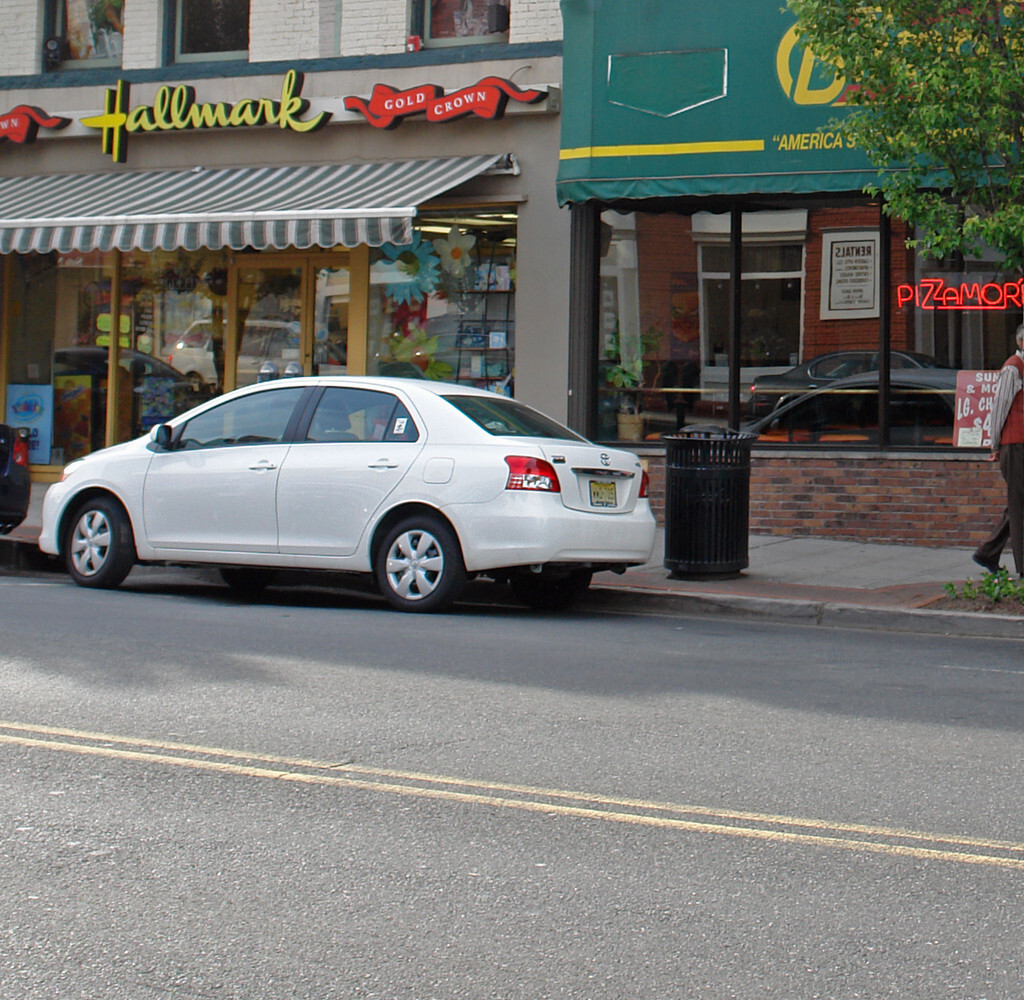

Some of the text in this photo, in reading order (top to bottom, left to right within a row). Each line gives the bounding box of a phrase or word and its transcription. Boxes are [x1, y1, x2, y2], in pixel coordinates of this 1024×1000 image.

[79, 69, 332, 163] Hallmark
[384, 91, 487, 116] GOLD CROWN
[966, 384, 975, 394] &
